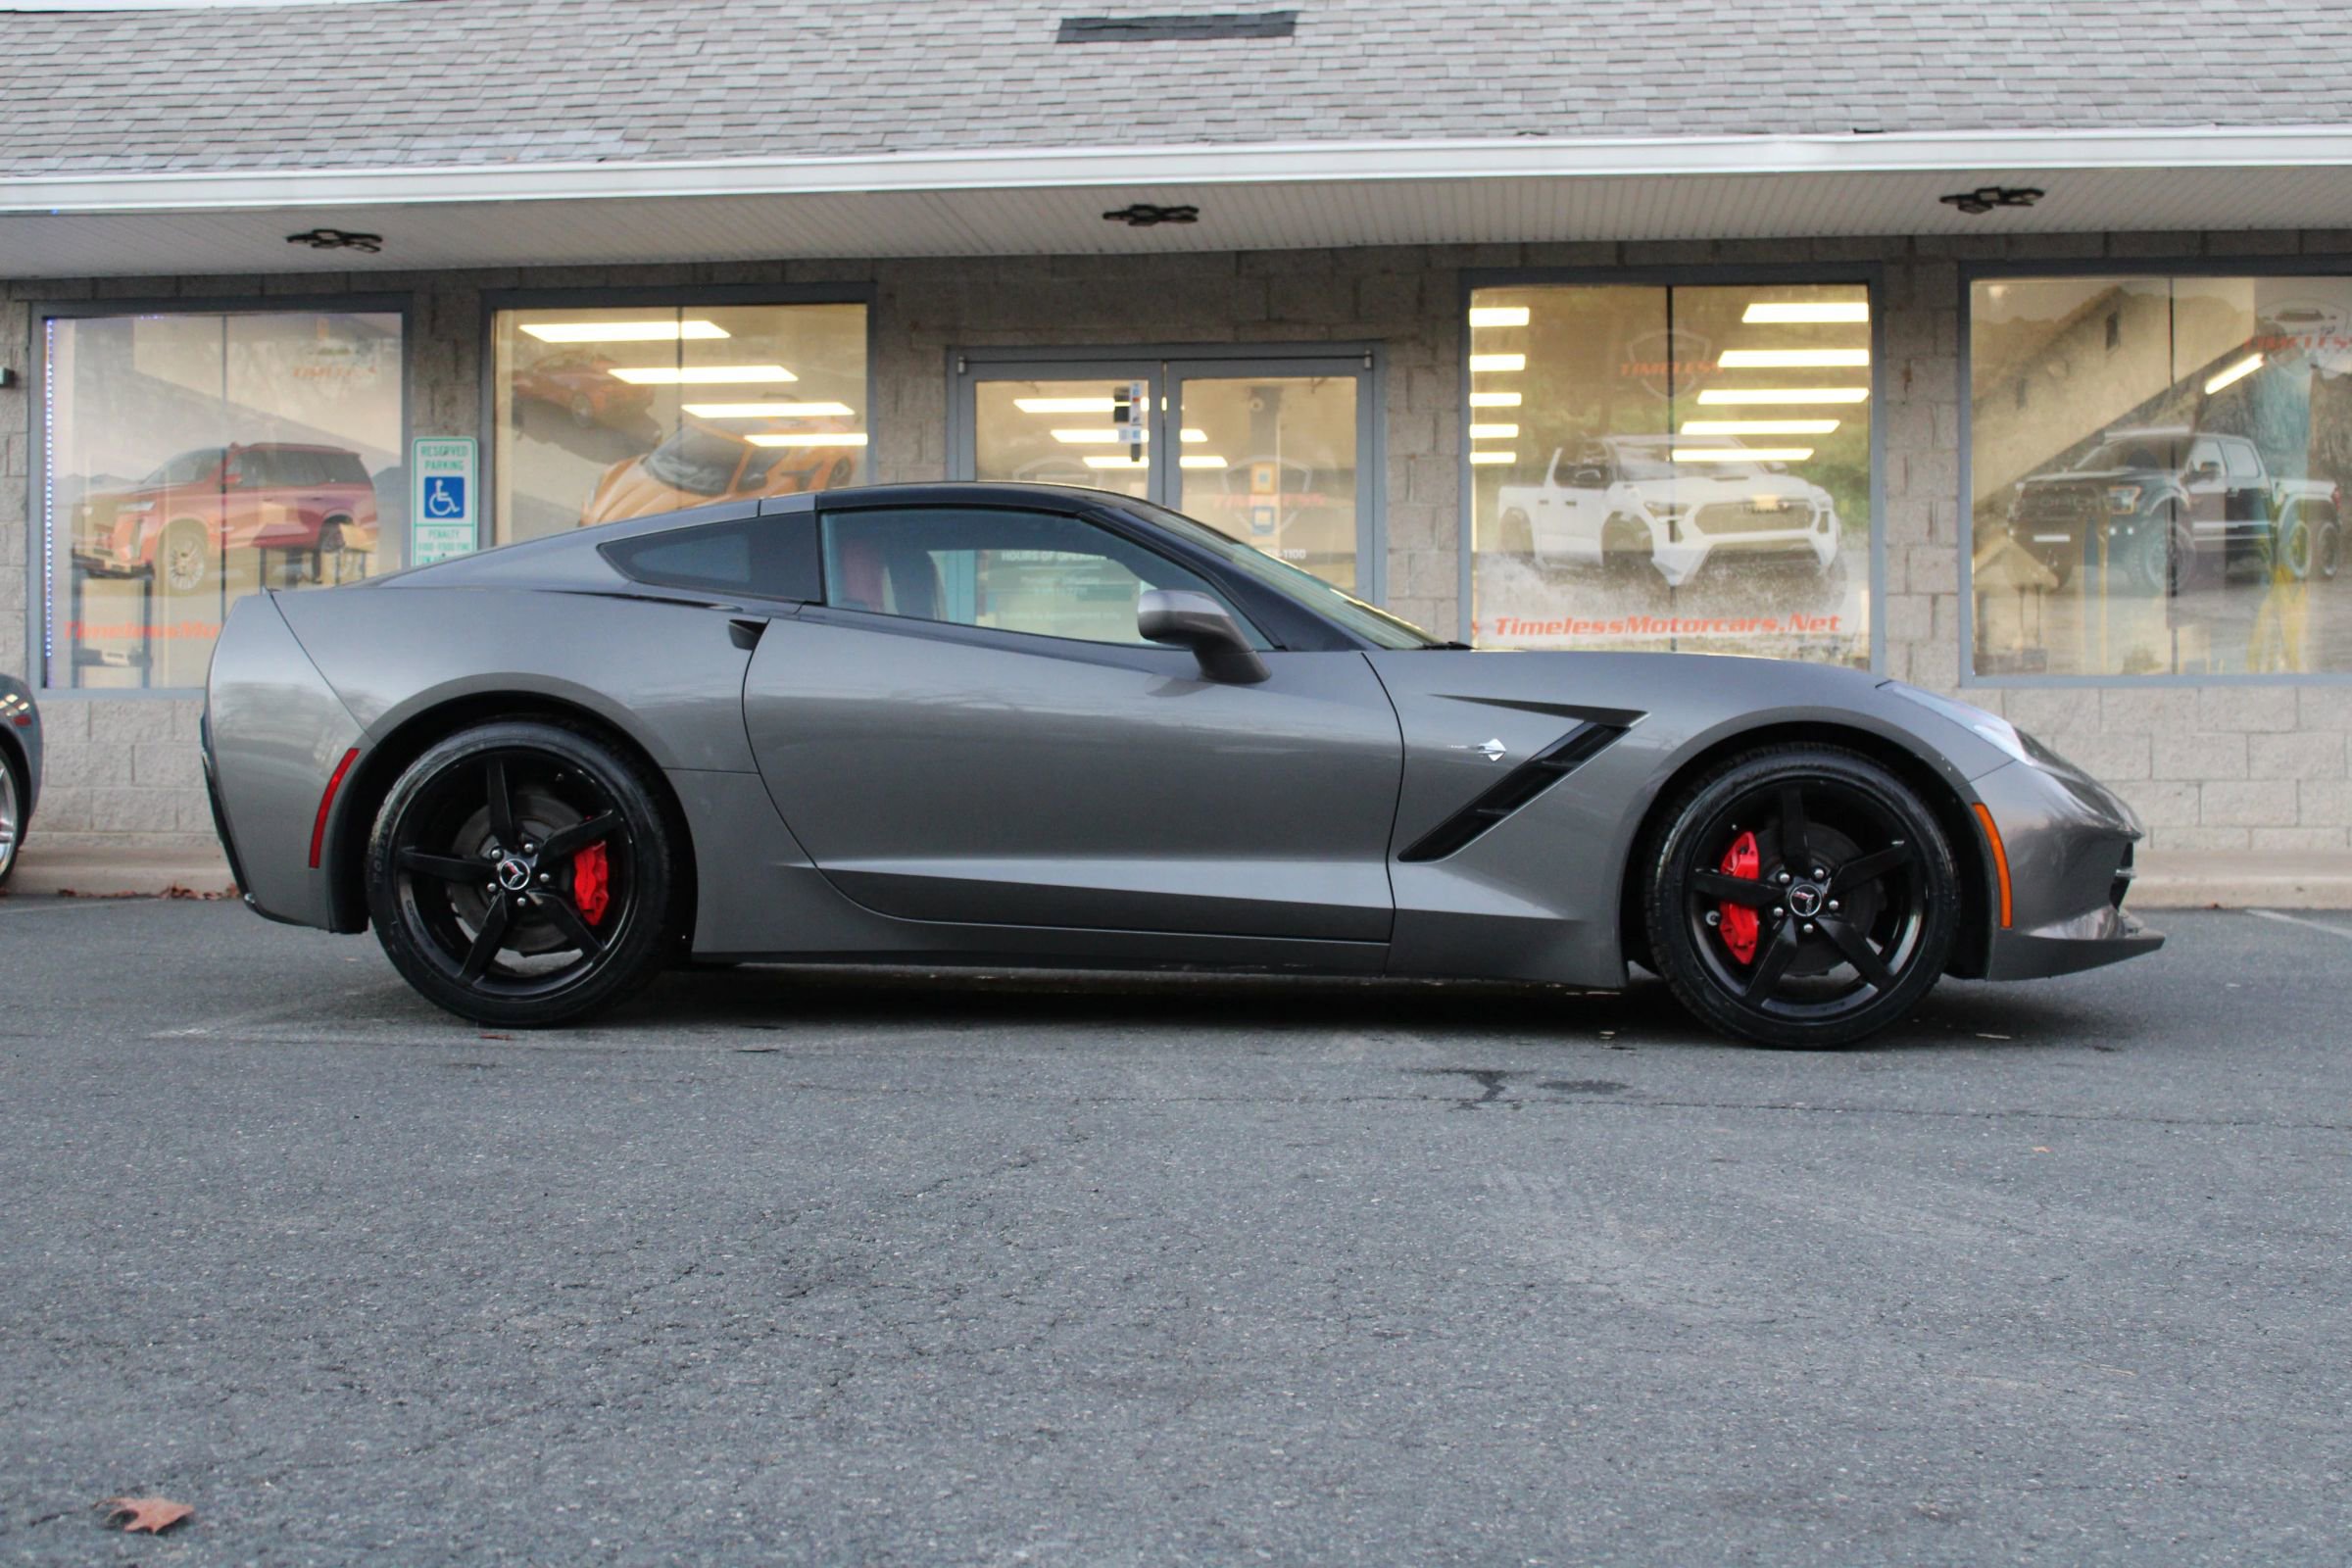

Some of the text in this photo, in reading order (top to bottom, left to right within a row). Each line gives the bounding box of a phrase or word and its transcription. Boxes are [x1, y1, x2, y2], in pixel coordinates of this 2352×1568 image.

[420, 445, 468, 457] RESERVED
[424, 460, 464, 471] PARKING
[1495, 612, 1841, 636] TimelessMotorcars.Net
